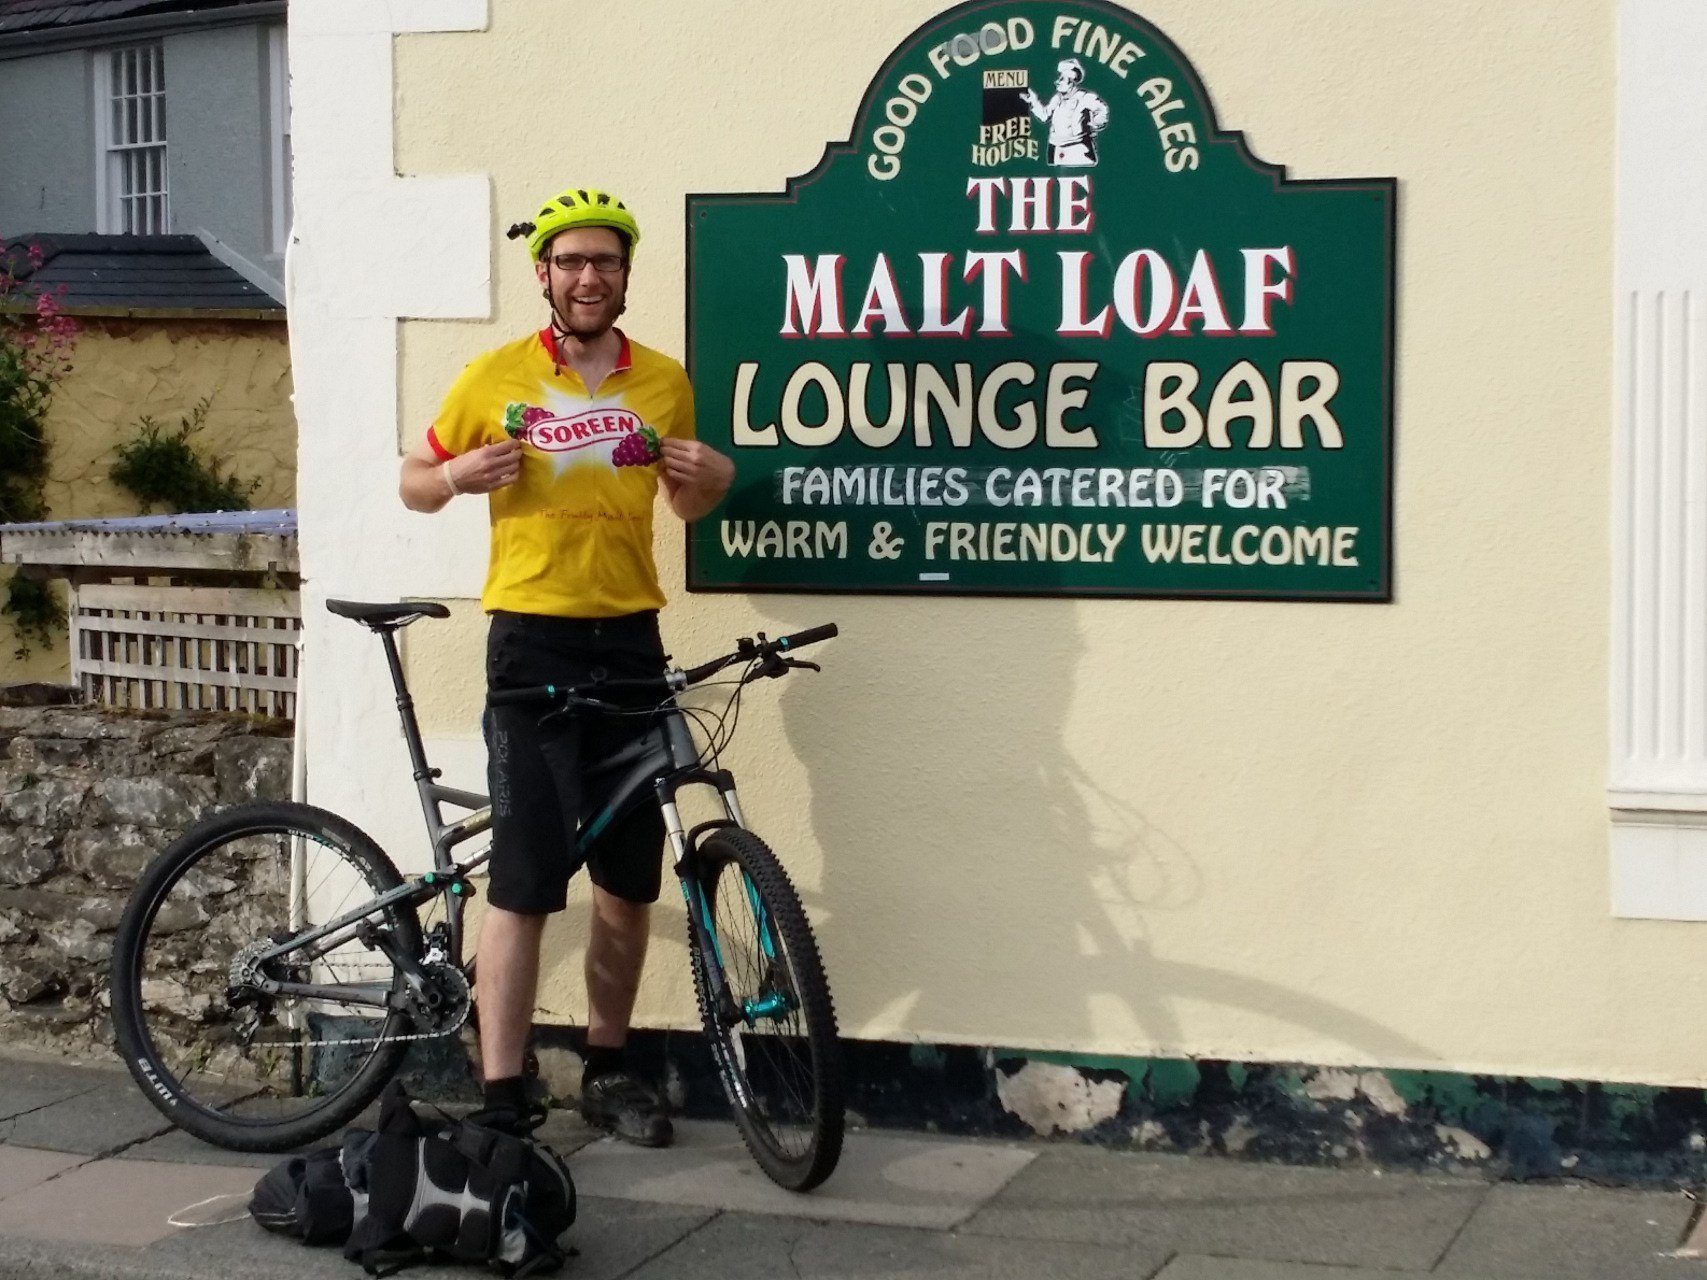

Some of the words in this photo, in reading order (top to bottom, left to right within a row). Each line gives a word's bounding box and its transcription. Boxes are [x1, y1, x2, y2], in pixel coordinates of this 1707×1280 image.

[868, 74, 932, 181] GOOD
[928, 17, 1034, 79] FOOD
[1052, 15, 1145, 78] FINE
[1137, 77, 1199, 173] ALES
[984, 71, 1026, 88] MENU
[971, 138, 1039, 167] HOUSE
[980, 117, 1031, 146] FREE
[967, 175, 1095, 234] THE
[780, 249, 1027, 339] MALT
[1056, 245, 1296, 339] LOAF
[732, 361, 1099, 449] LOUNGE
[1144, 359, 1345, 450] BAR
[539, 416, 634, 443] SOREEN
[782, 466, 970, 507] FAMILIES
[985, 468, 1182, 509] CATERED
[1202, 468, 1287, 510] FOR
[720, 520, 848, 559] WARM
[868, 522, 904, 560] &
[925, 522, 1127, 563] FRIENDLY
[1141, 524, 1359, 567] WELCOME
